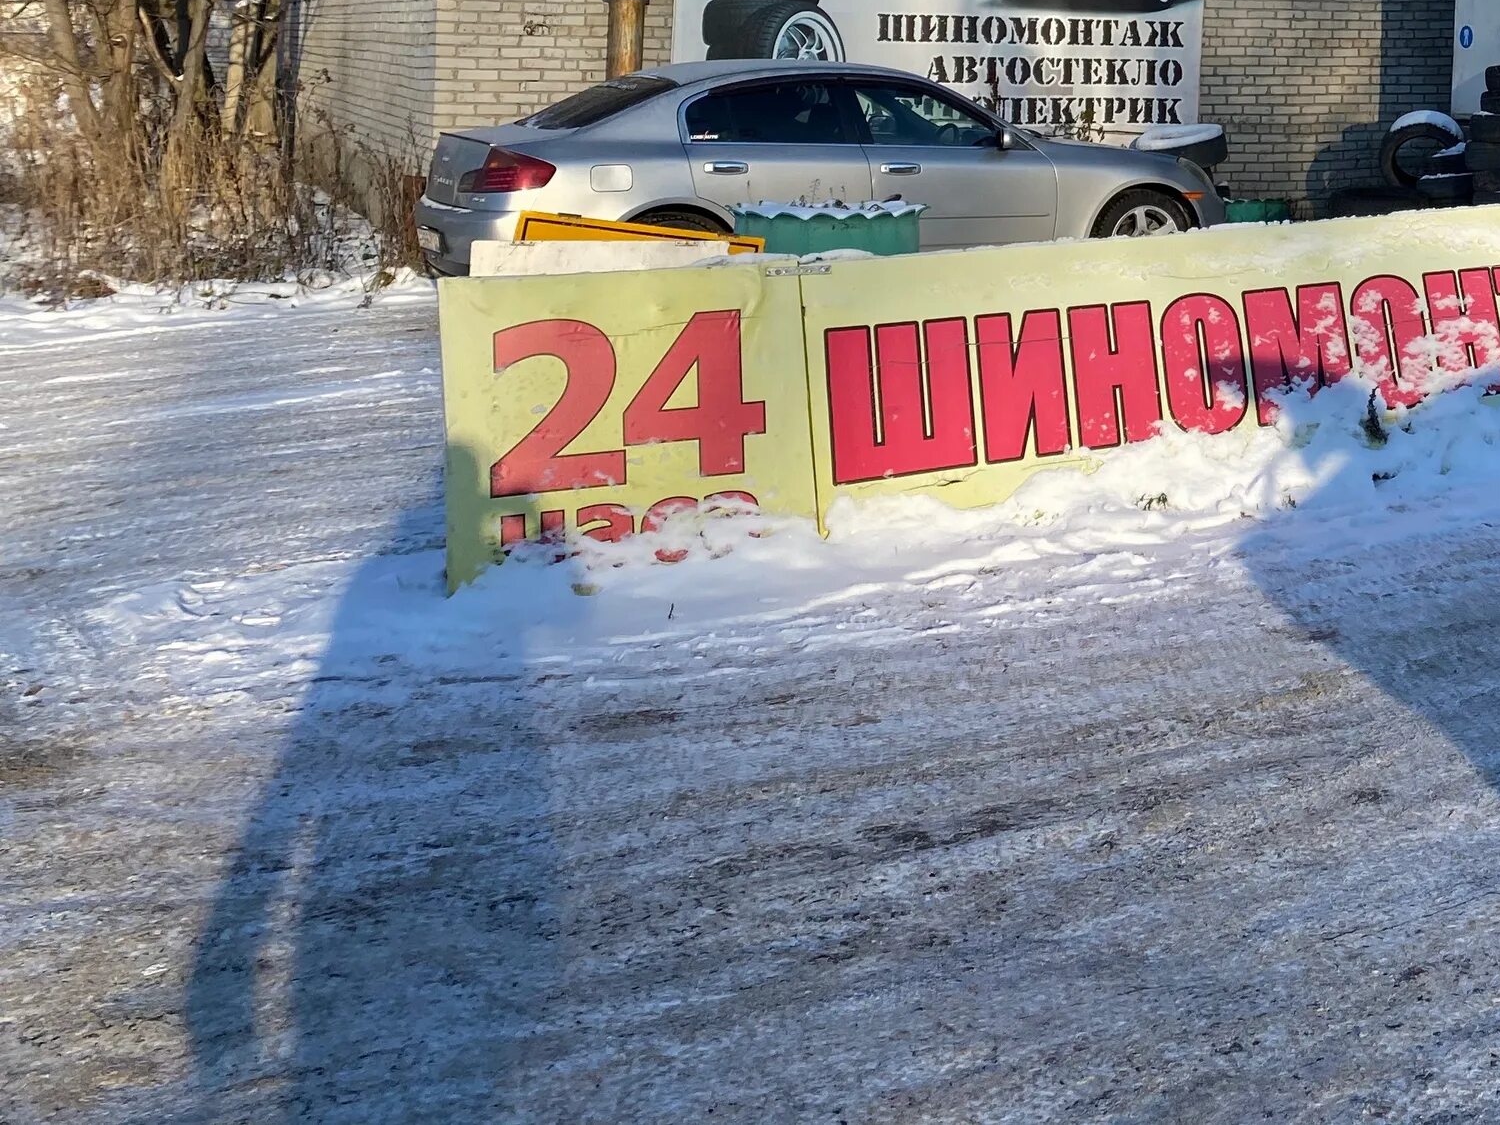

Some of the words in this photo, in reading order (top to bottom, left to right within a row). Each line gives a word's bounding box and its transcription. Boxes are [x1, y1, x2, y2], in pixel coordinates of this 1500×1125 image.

[877, 13, 1185, 48] ШИНОМОНТАЖ
[927, 55, 1184, 86] АВТОСТЕКЛО
[490, 309, 767, 499] 24
